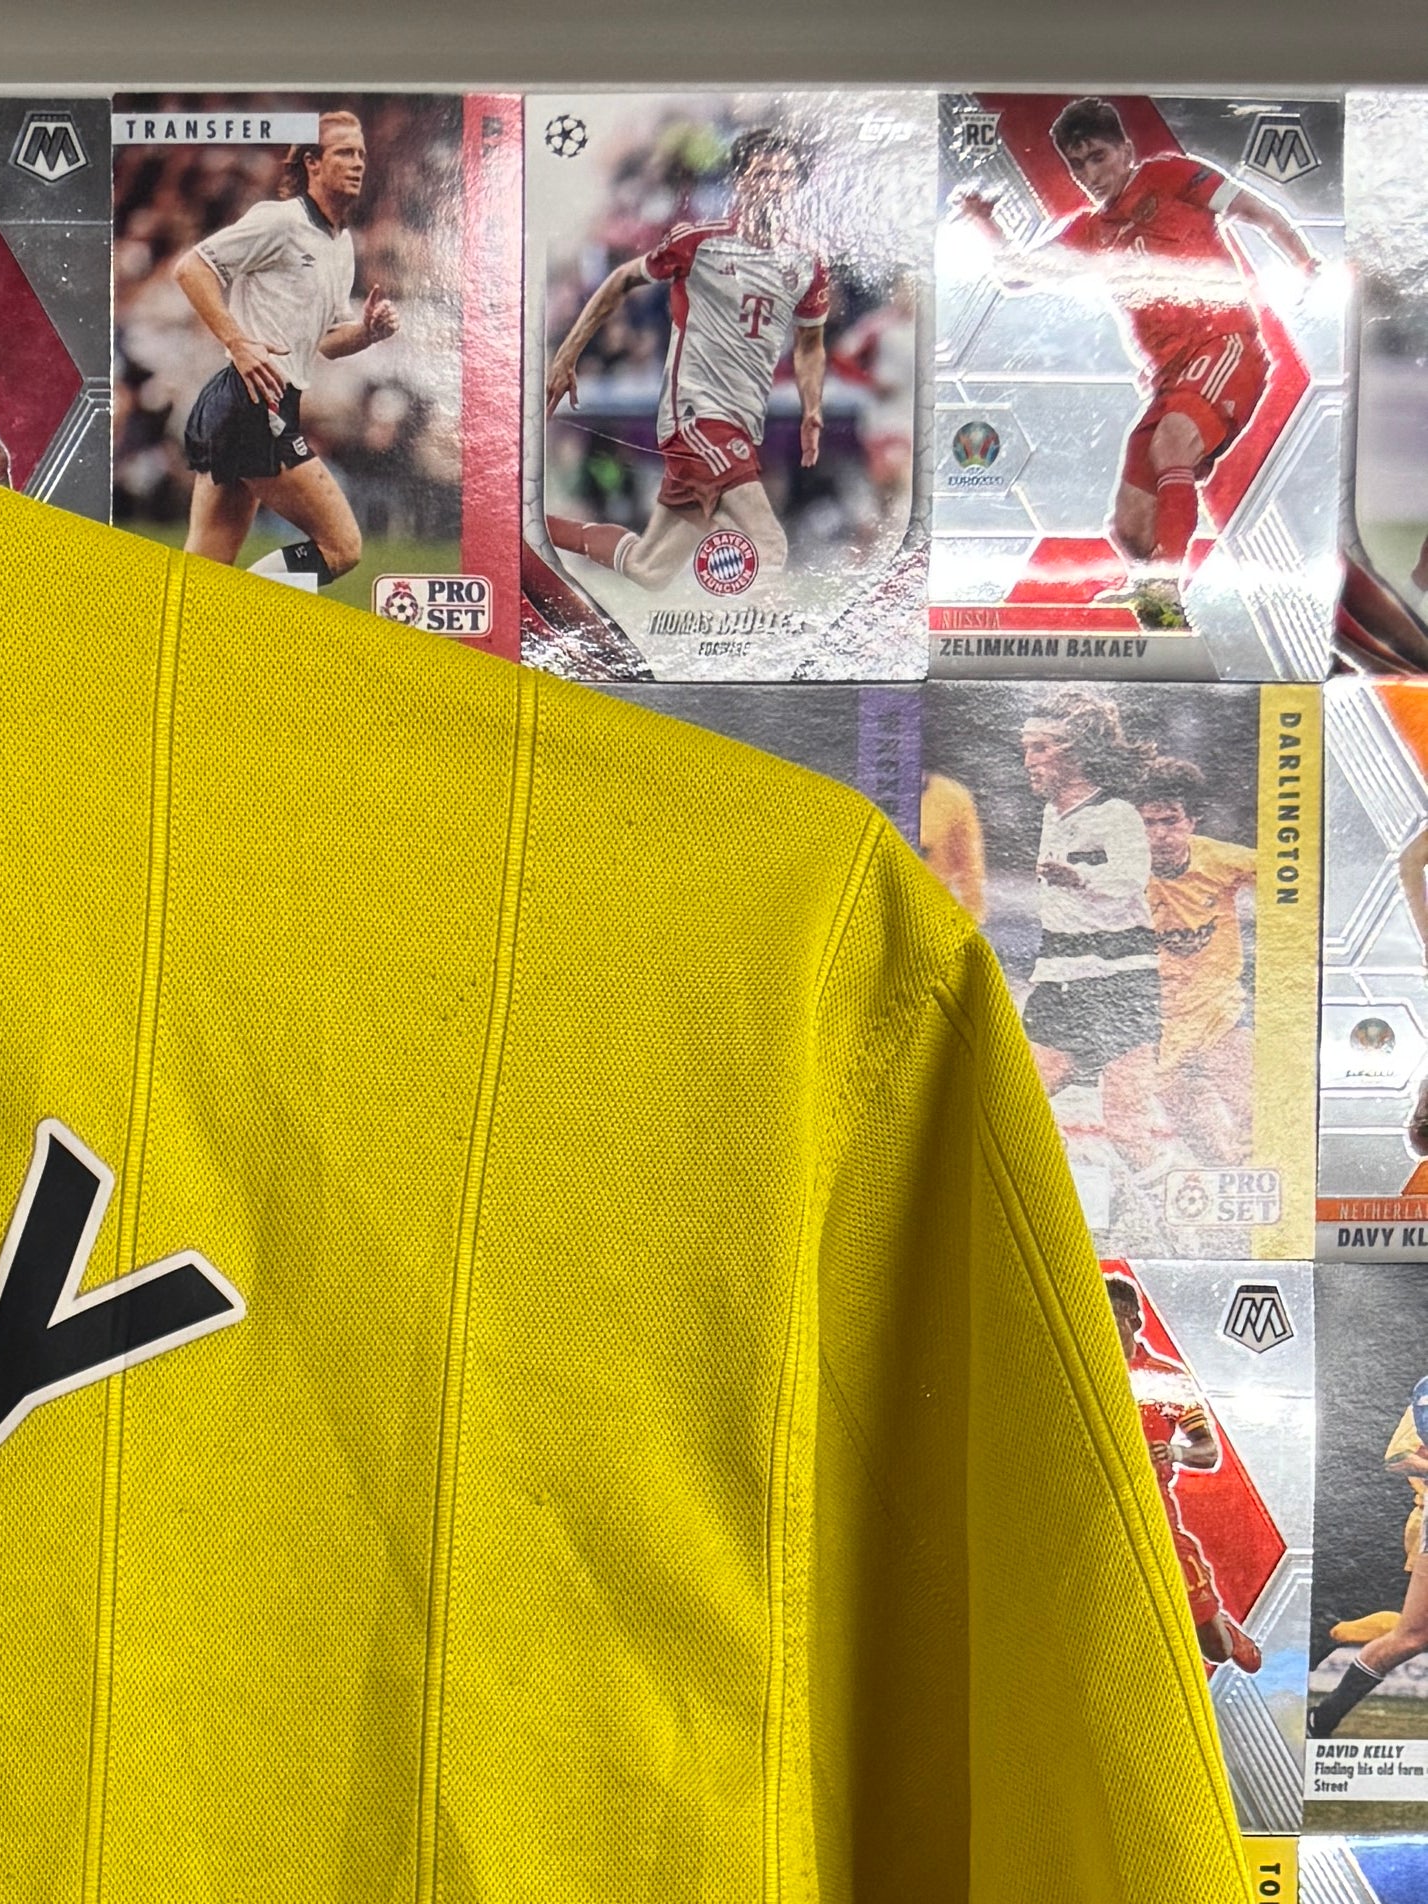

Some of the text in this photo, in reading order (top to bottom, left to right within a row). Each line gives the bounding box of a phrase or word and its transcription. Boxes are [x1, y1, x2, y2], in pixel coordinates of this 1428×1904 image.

[125, 118, 274, 140] TRANSFER
[426, 580, 485, 604] PRO
[425, 606, 485, 632] SET
[938, 639, 1148, 659] ZELIMKHAN BAKAEV
[1275, 711, 1301, 906] DARLINGTON
[1217, 1171, 1277, 1193] PRO
[1217, 1198, 1277, 1221] SET
[1337, 1227, 1395, 1248] DAVY
[1315, 1743, 1404, 1759] DAVID KELLY
[1314, 1760, 1354, 1779] Finding
[1376, 1761, 1394, 1776] old
[1395, 1762, 1424, 1776] form
